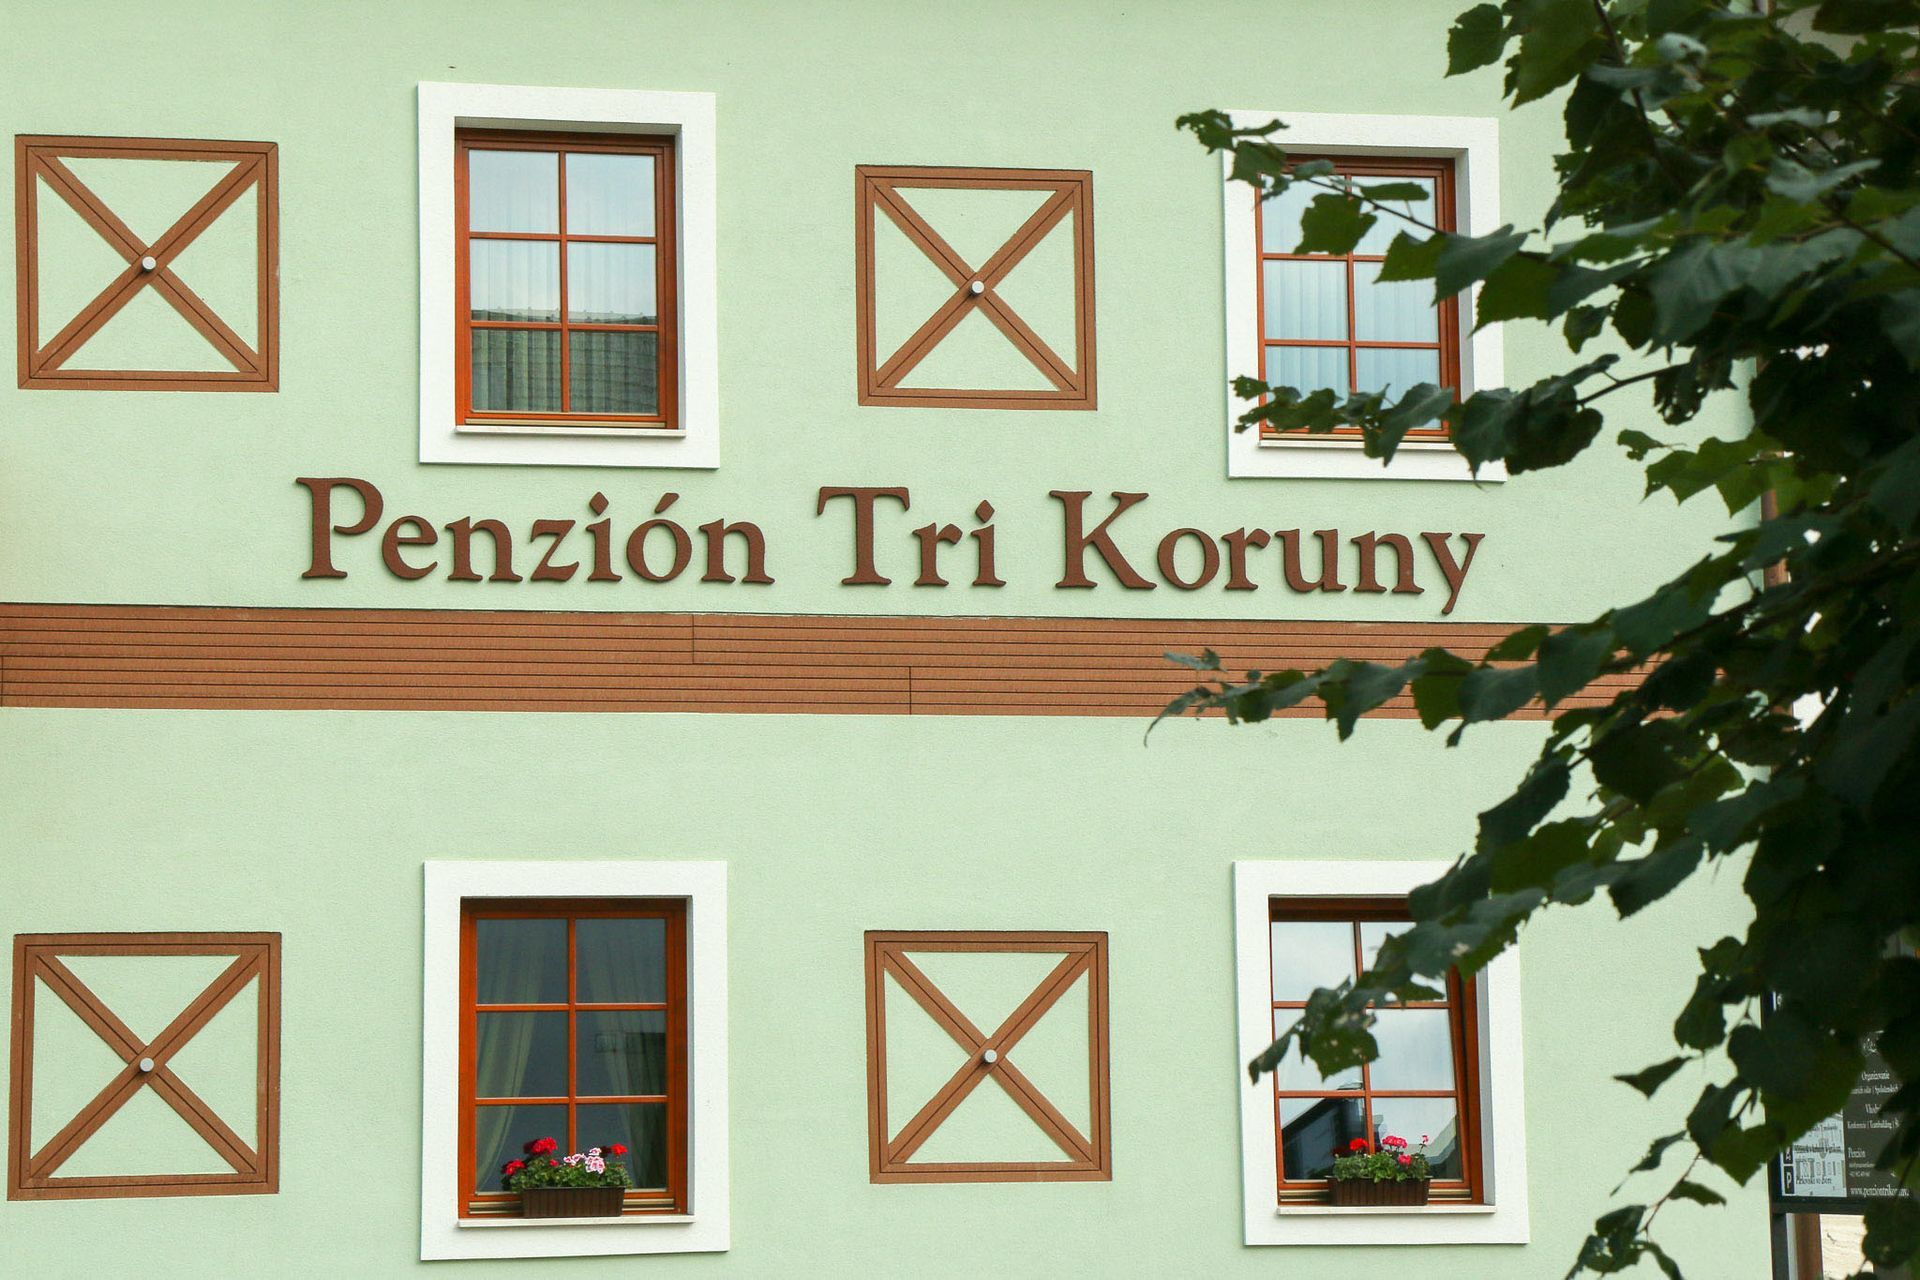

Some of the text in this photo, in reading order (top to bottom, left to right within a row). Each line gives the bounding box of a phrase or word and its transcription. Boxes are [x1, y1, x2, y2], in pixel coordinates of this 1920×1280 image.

[296, 476, 1487, 617] Penzión Tri Koruny
